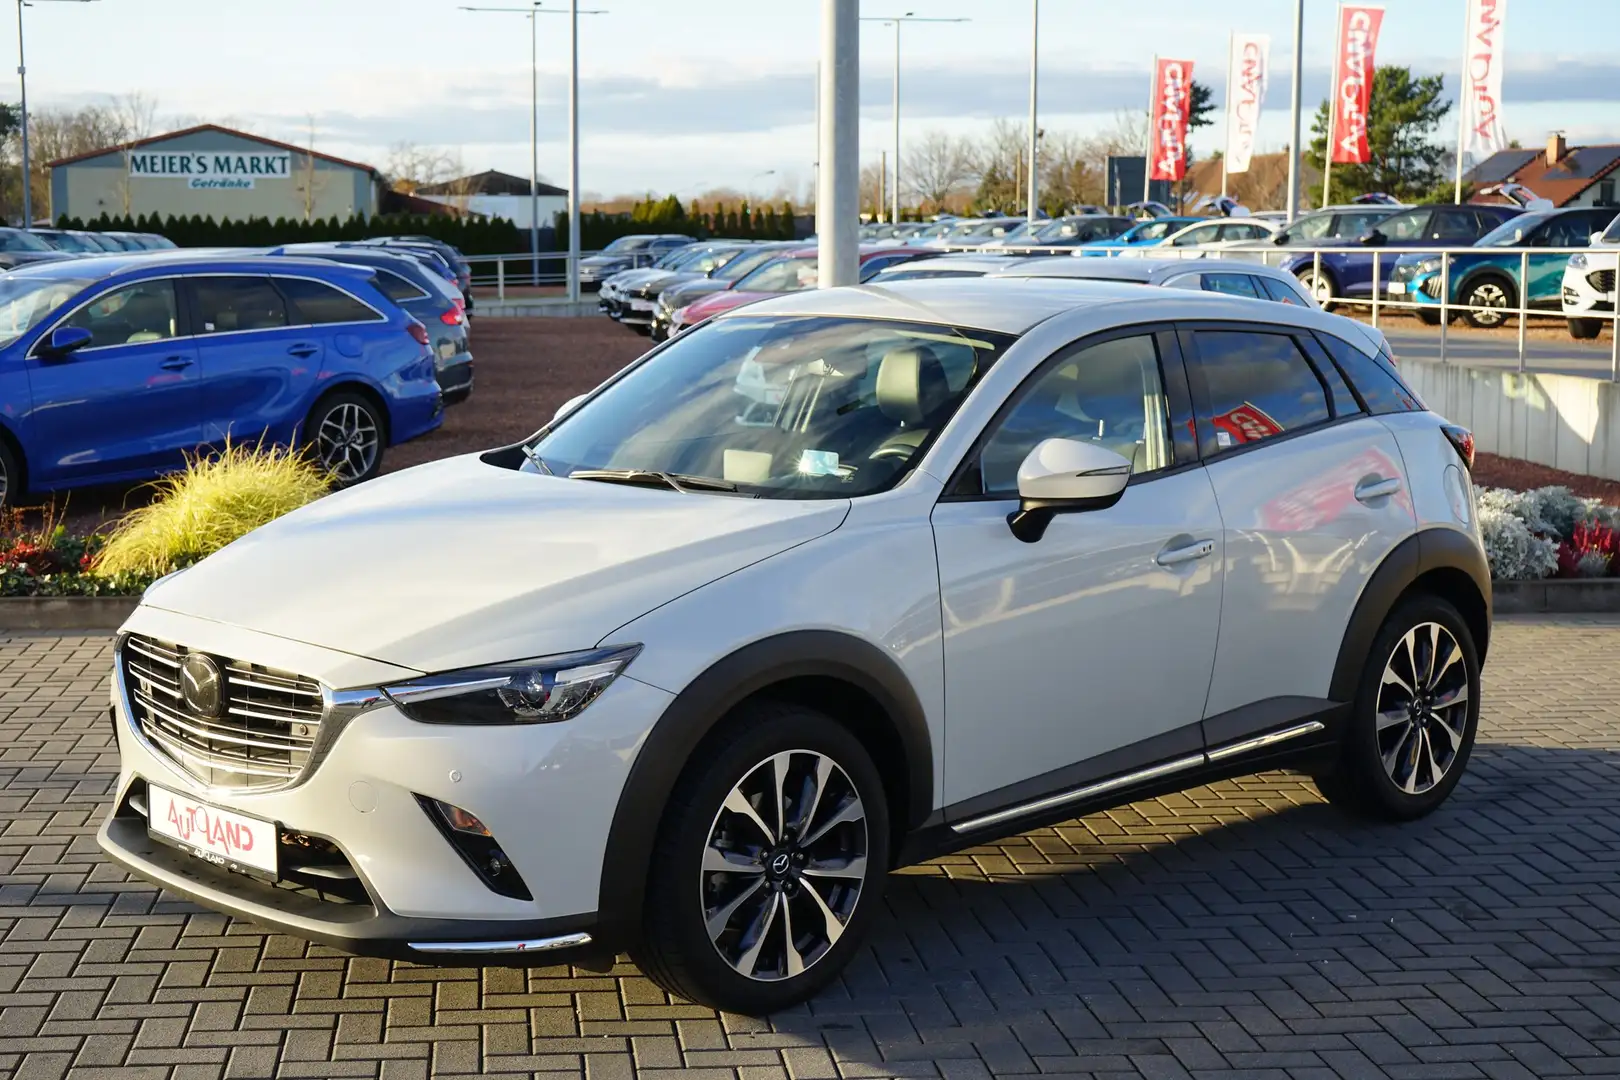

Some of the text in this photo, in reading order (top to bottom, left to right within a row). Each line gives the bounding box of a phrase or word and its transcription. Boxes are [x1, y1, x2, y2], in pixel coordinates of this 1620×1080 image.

[1340, 11, 1374, 156] AUTOLAND
[130, 153, 289, 174] MEIER'S MARKT
[191, 178, 250, 188] Getränke
[168, 798, 254, 855] AUTOLAND
